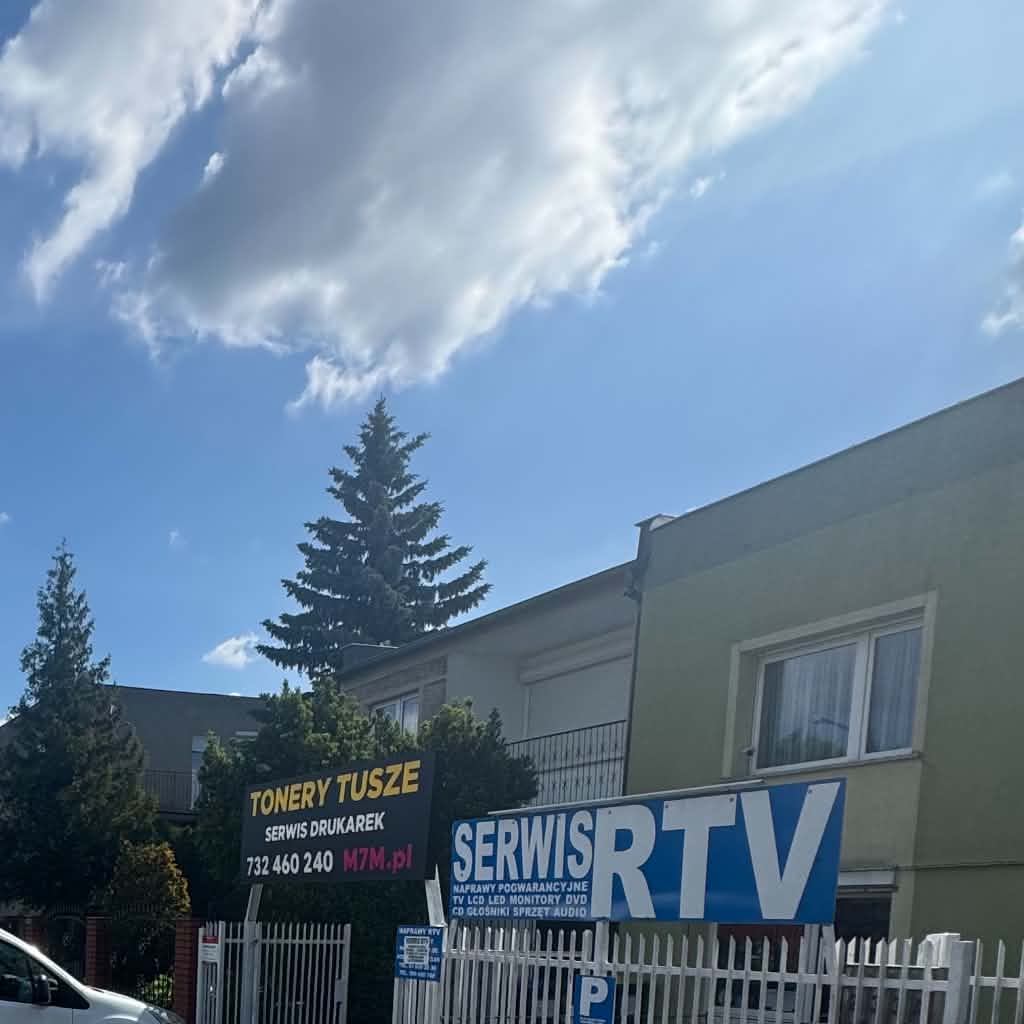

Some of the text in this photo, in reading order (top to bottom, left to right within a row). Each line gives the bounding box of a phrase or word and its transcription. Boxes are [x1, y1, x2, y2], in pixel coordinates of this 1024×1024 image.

[250, 760, 421, 816] TONERY TUSZE
[265, 812, 385, 842] SERWIS DRUKAREK
[247, 843, 413, 876] 732 460 240 M7M.pl
[453, 782, 841, 919] SERWIS RTV
[452, 894, 587, 905] TV LCD LED MONITORY DVD
[453, 883, 496, 894] NAPRAWY
[452, 907, 464, 916] CD
[554, 907, 587, 917] AUDIO
[579, 976, 608, 1016] P
